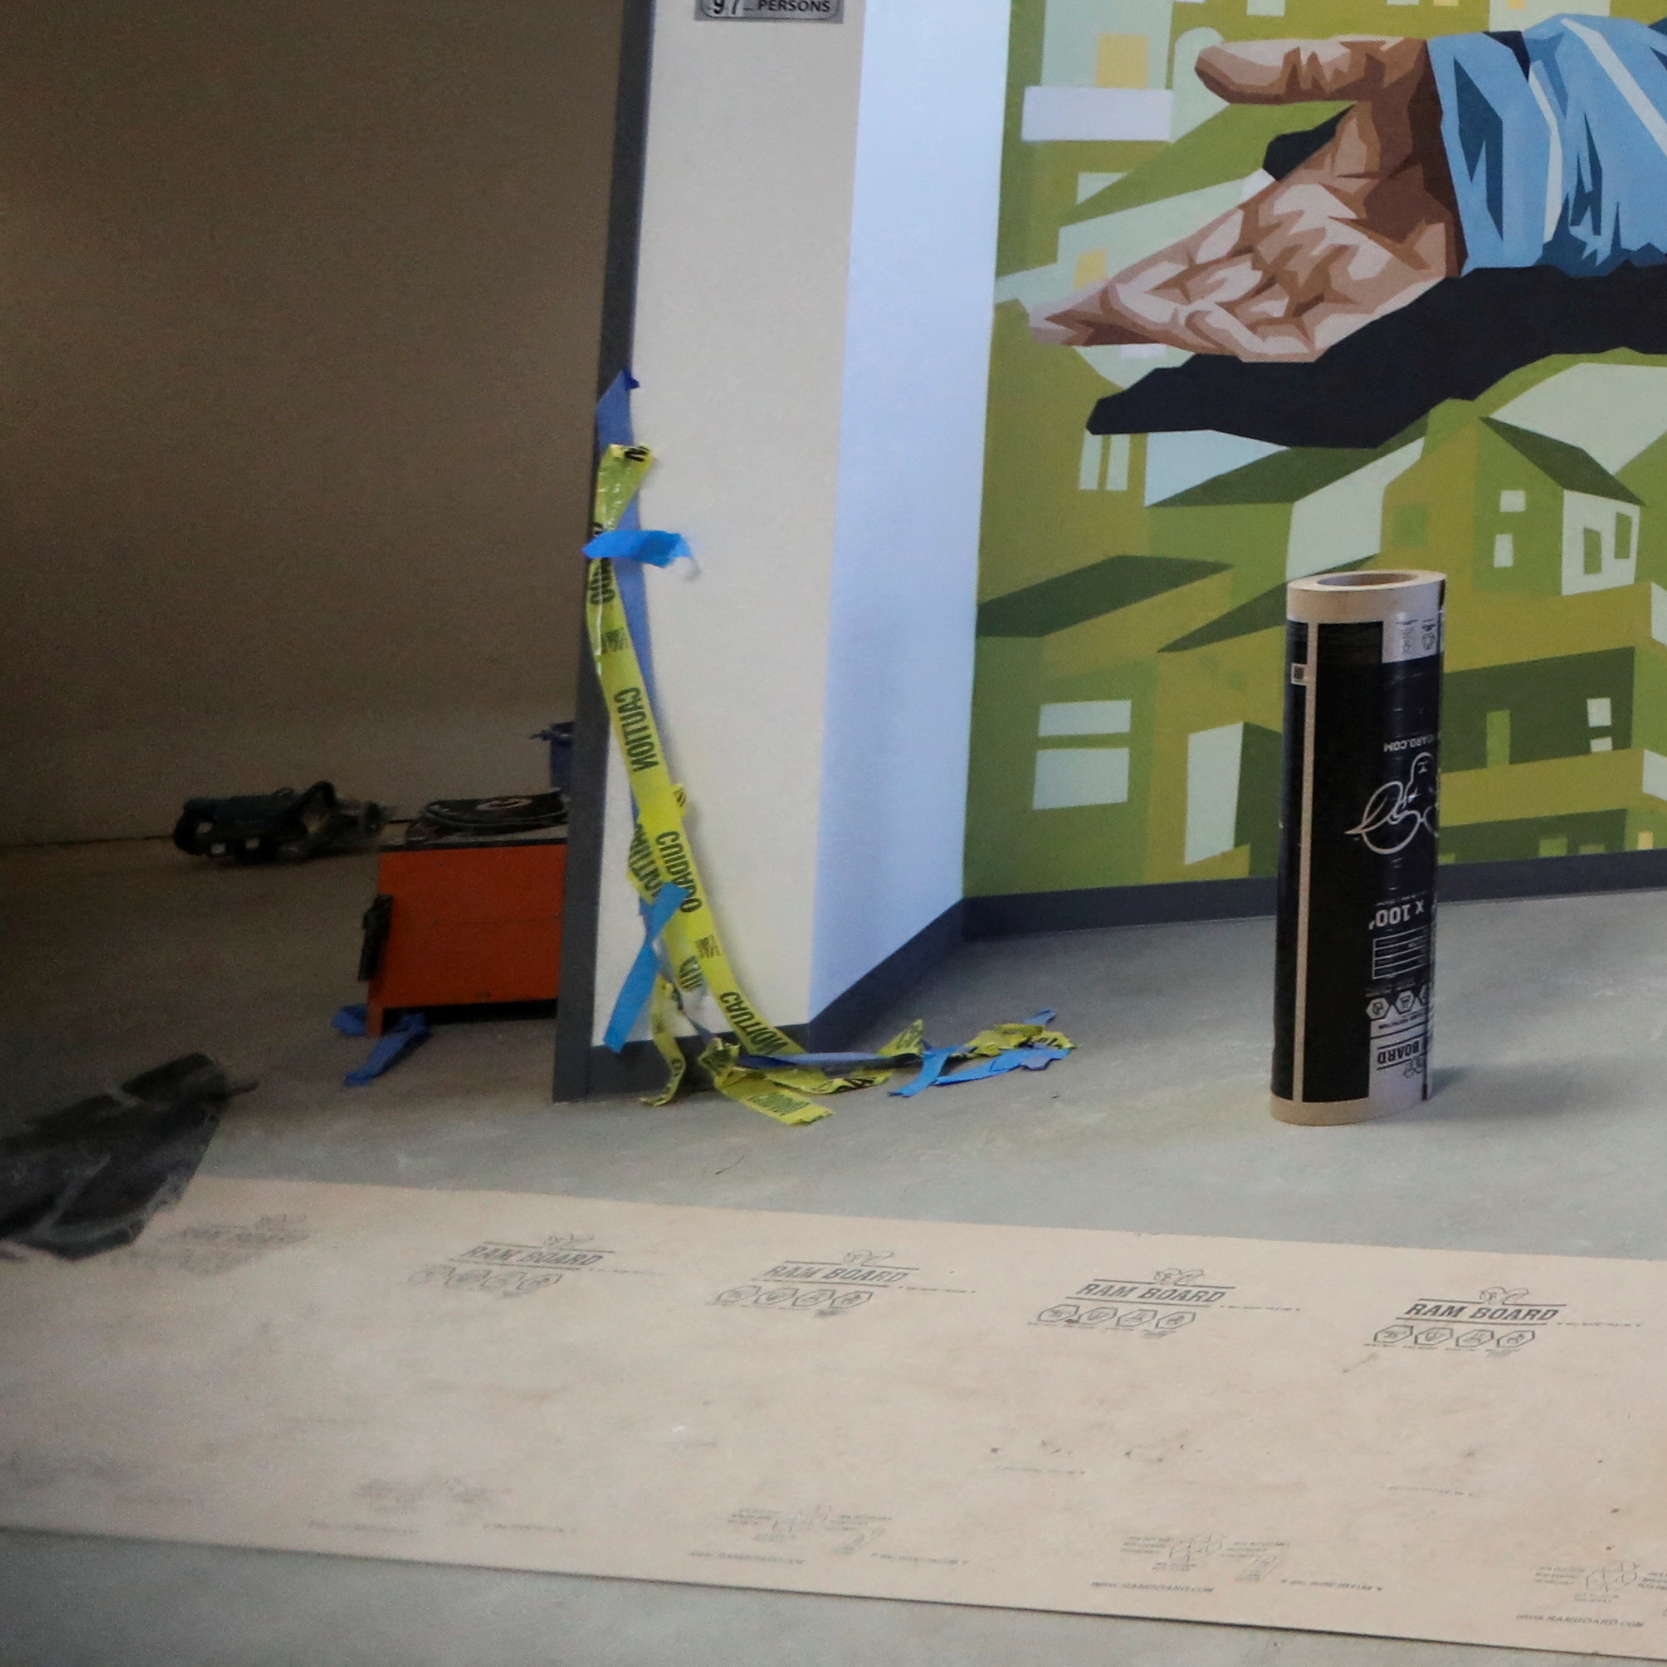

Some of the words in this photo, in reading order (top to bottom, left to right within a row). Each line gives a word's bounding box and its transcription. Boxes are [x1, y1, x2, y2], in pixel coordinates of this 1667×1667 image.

[757, 0, 831, 13] PERSONS
[1377, 1041, 1420, 1064] BOARD
[764, 1265, 819, 1278] RAM
[822, 1268, 910, 1282] BOARD
[1075, 1284, 1135, 1298] RAM
[1138, 1287, 1227, 1303] BOARD
[1404, 1303, 1467, 1317] RAM
[1469, 1307, 1559, 1321] BOARD
